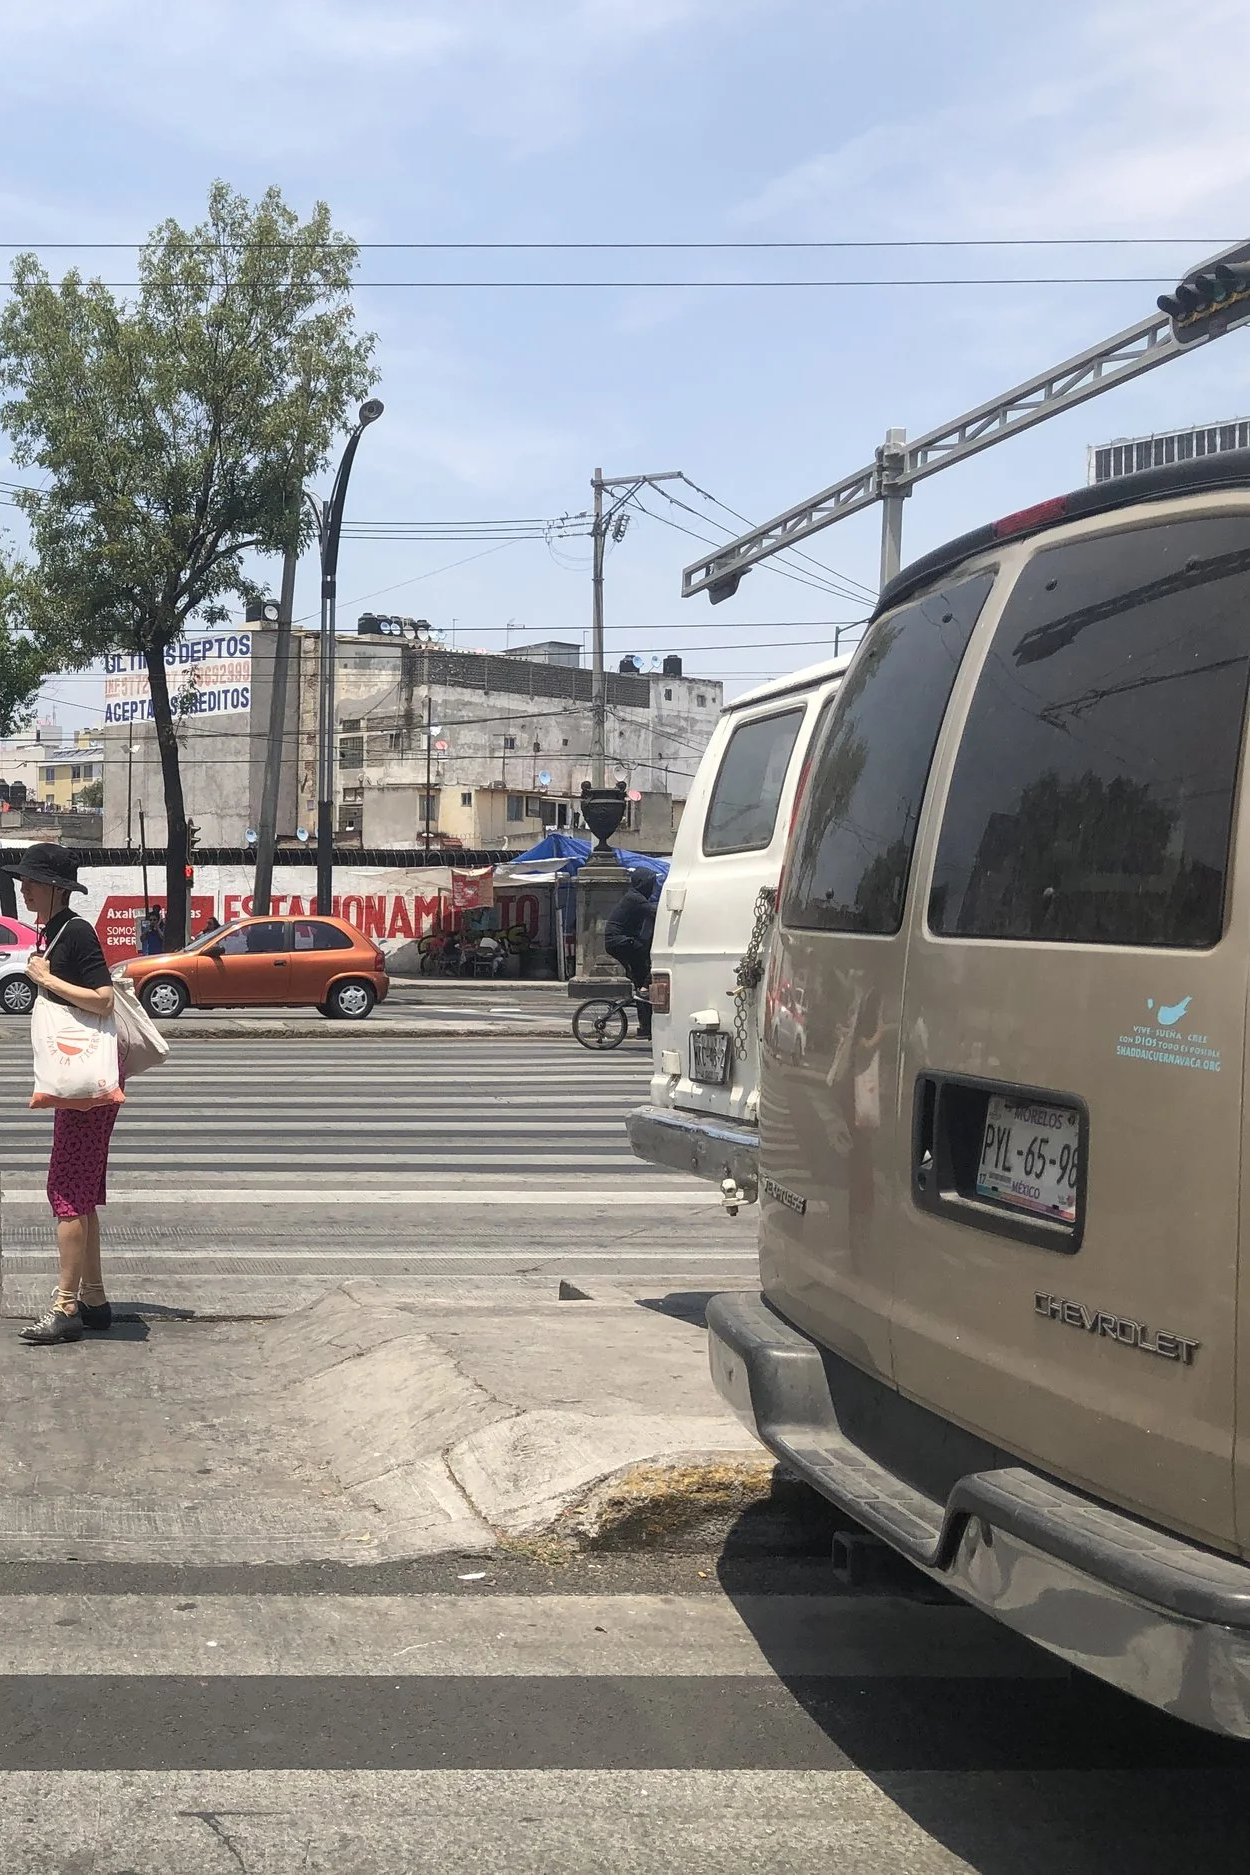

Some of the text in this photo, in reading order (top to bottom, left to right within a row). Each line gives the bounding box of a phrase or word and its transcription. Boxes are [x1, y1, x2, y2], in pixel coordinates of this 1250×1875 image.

[179, 634, 251, 664] DEPTOS
[1133, 1025, 1151, 1035] VIVE
[1119, 1035, 1133, 1044] CON
[1134, 1035, 1157, 1047] DIOS
[1158, 1041, 1179, 1052] TODO
[1116, 1045, 1222, 1073] SHADDAICUERNAVACA.ORG
[1013, 1107, 1063, 1130] MORELOS
[1010, 1180, 1041, 1199] MÉXICO
[1033, 1289, 1201, 1366] CHEVROLET
